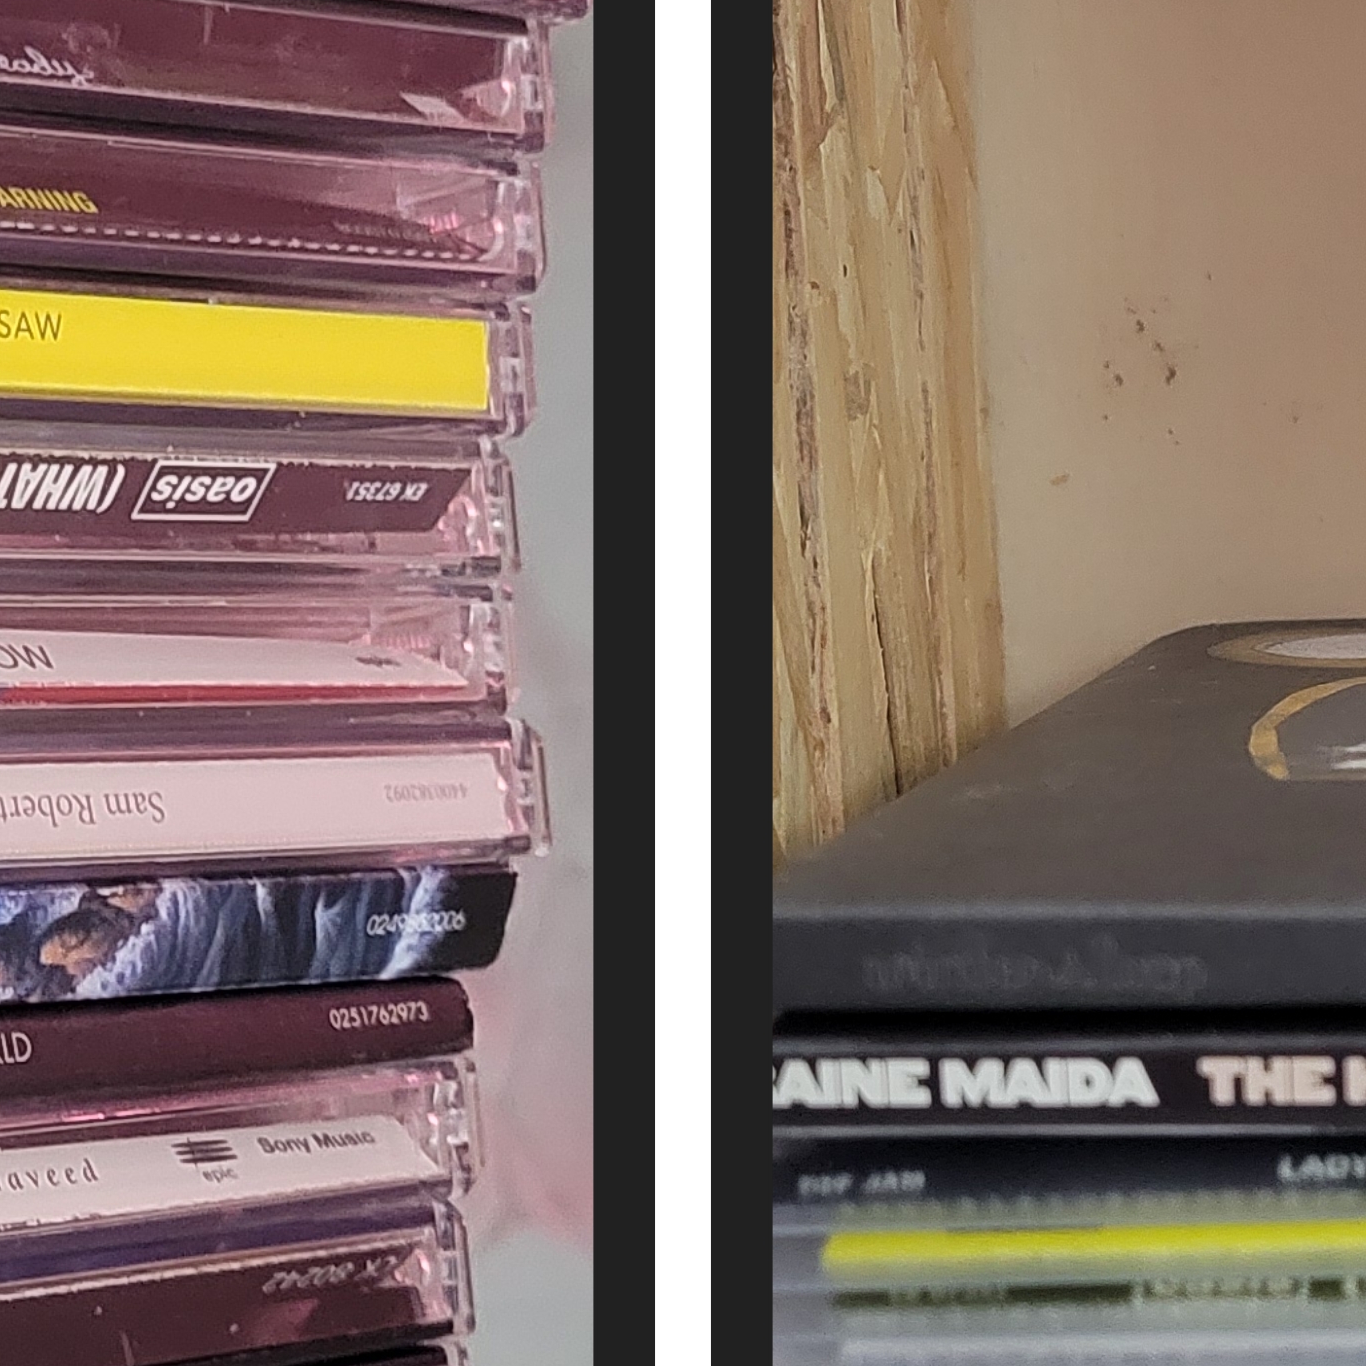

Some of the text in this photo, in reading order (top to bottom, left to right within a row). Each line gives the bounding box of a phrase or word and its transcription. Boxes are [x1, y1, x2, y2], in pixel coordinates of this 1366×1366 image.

[102, 791, 168, 824] Sam
[329, 1000, 431, 1031] 0251762973
[773, 1055, 932, 1109] AINE
[939, 1055, 1160, 1110] MAIDA
[1197, 1055, 1338, 1109] THE
[256, 1135, 312, 1155] Sony
[311, 1129, 376, 1149] Music
[202, 1166, 239, 1184] epic
